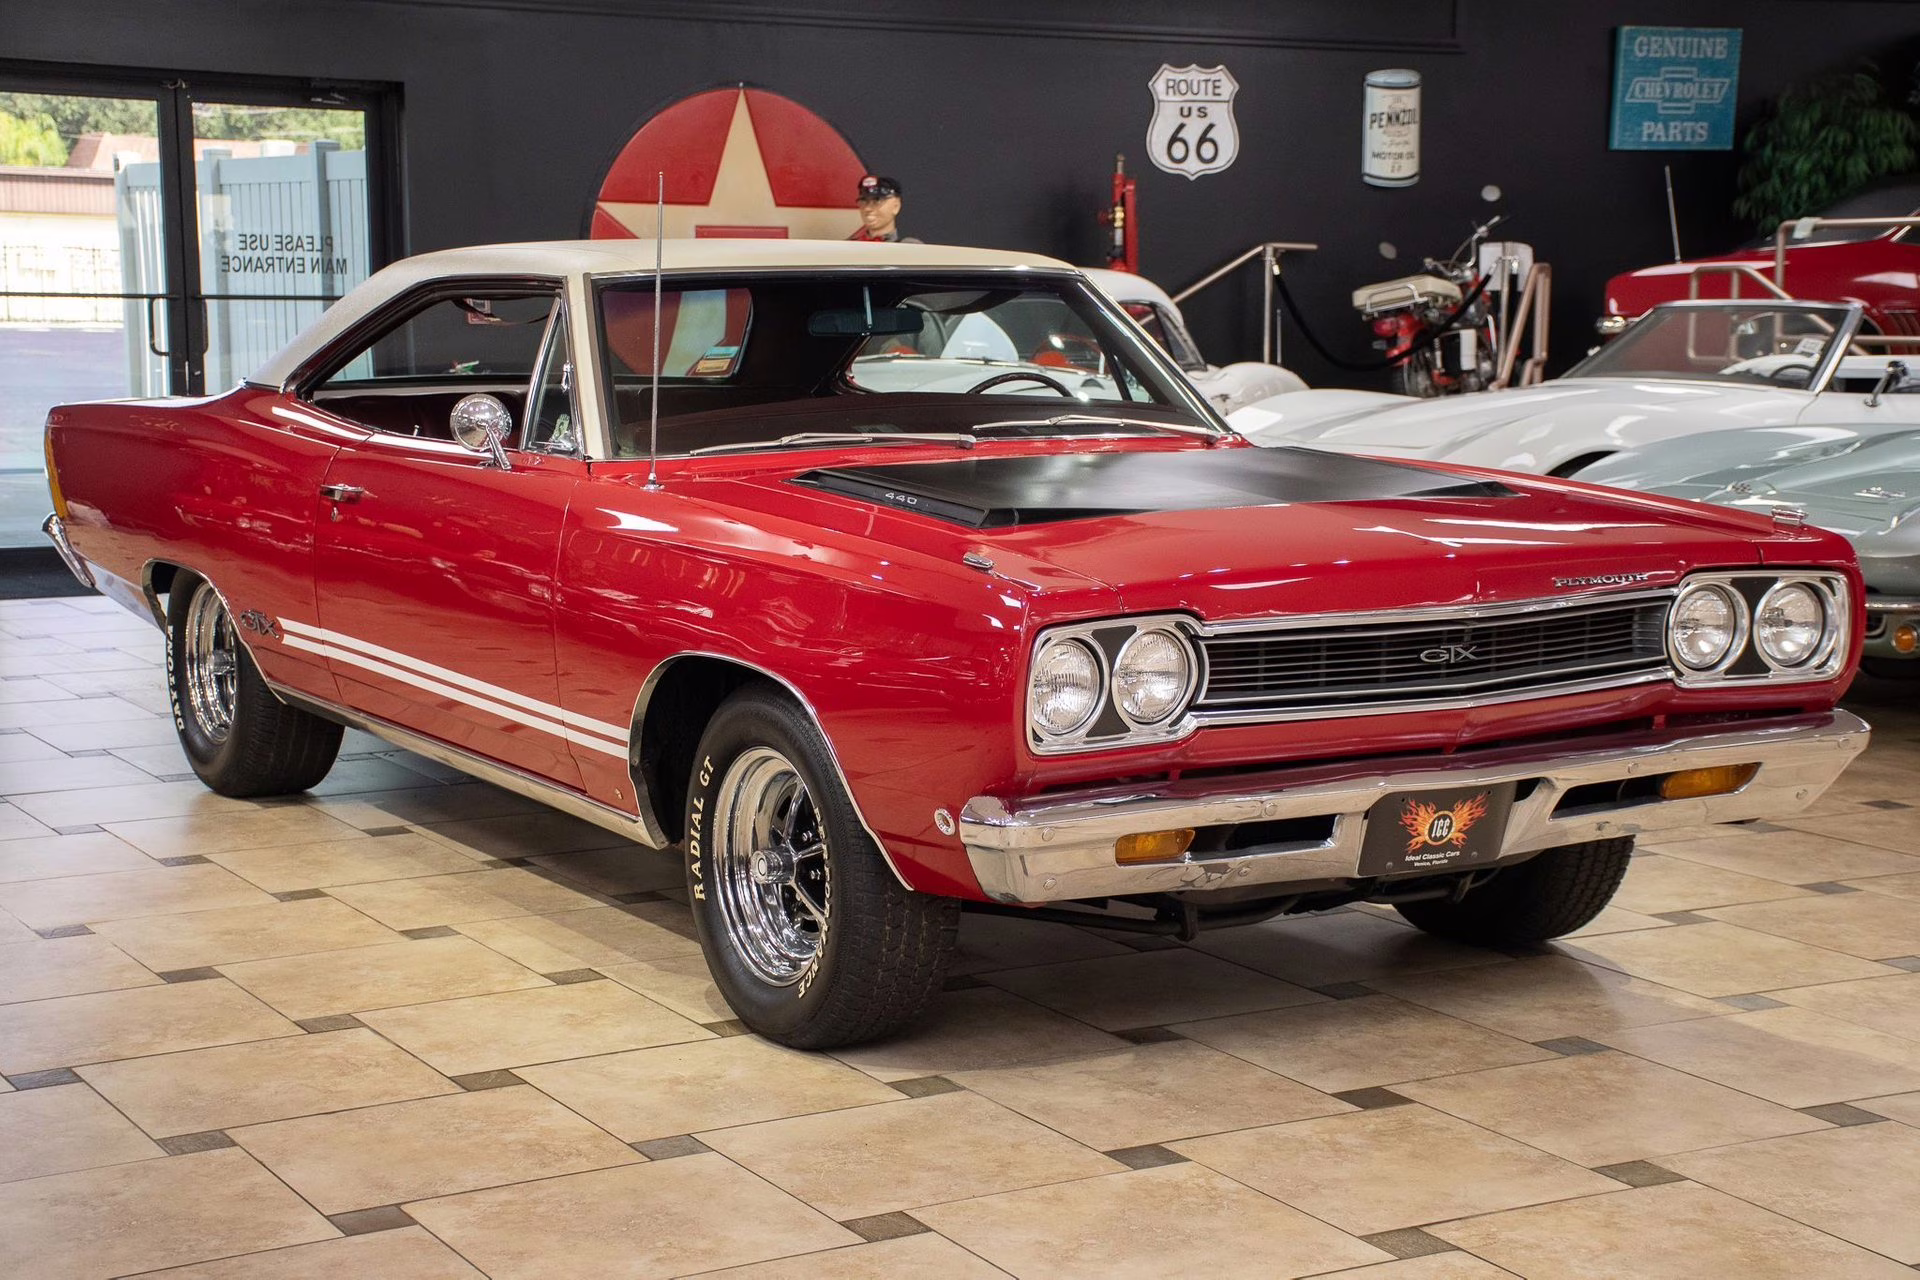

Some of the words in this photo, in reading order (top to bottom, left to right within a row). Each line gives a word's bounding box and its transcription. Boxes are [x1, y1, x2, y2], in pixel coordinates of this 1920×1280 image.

[1634, 35, 1729, 58] GENUINE
[1165, 78, 1222, 96] ROUTE
[1632, 80, 1723, 99] CHEVROLET
[1179, 103, 1209, 119] US
[1641, 121, 1709, 142] PARTS
[1166, 122, 1219, 165] 66
[884, 492, 918, 505] 440
[1554, 573, 1649, 588] PLYMOUTH
[239, 609, 280, 640] GTX
[1419, 644, 1479, 664] GTX
[166, 625, 186, 731] DAYTONA
[690, 797, 706, 901] RADIAL
[699, 755, 715, 788] GT
[1431, 817, 1451, 839] ICC
[1405, 854, 1422, 862] Ideal
[1422, 852, 1445, 860] Classic
[1445, 850, 1460, 858] Cars
[798, 806, 831, 998] PERFORMANCE
